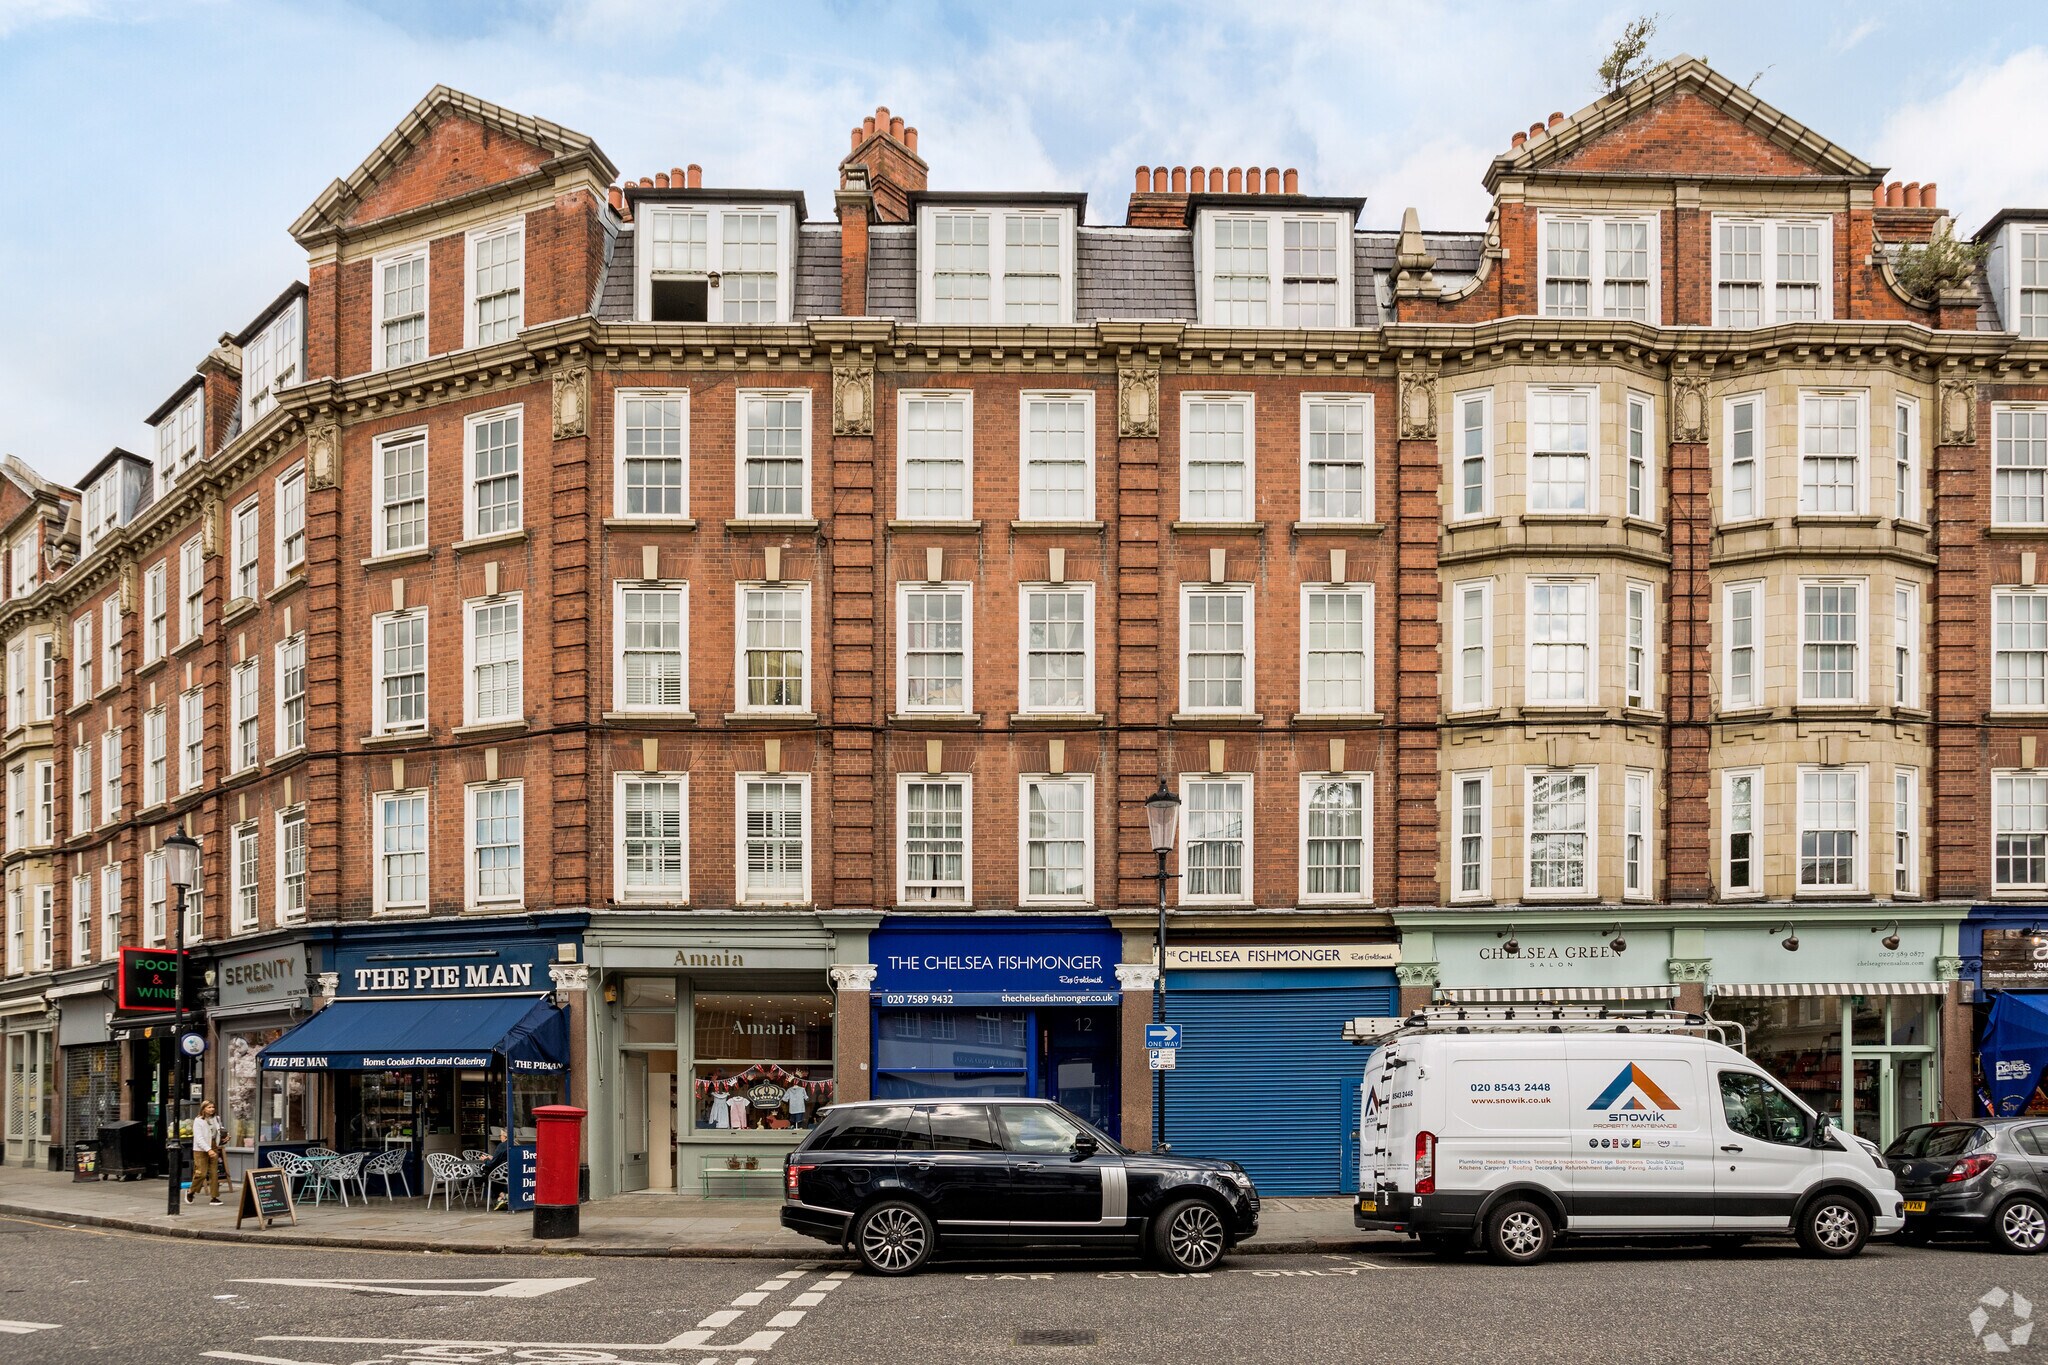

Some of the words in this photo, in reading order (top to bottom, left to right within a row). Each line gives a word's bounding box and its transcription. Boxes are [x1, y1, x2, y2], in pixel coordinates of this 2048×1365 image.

[674, 949, 743, 966] Amaia
[1178, 950, 1241, 962] CHELSEA
[1247, 949, 1341, 962] FISHMONGER
[1565, 947, 1622, 959] GREEN
[135, 960, 178, 971] FOOD
[888, 956, 920, 970] THE
[924, 956, 993, 970] CHELSEA
[998, 955, 1102, 970] FISHMONGER
[225, 957, 295, 985] SERENITY
[355, 968, 409, 990] THE
[414, 966, 459, 989] PIE
[464, 963, 532, 987] MAN
[153, 974, 163, 984] &
[887, 995, 904, 1004] 020
[907, 995, 929, 1004] 7589
[931, 995, 953, 1004] 9432
[1001, 994, 1113, 1004] thechelseafishmonger.co.uk
[731, 1020, 796, 1035] Amaia
[1075, 1017, 1092, 1031] 12
[269, 1058, 287, 1067] THE
[289, 1058, 305, 1067] PIE
[306, 1057, 328, 1067] MAN
[363, 1058, 385, 1066] Home
[386, 1057, 414, 1066] Cooked
[415, 1057, 436, 1066] Food
[436, 1057, 452, 1065] and
[453, 1056, 487, 1067] Catering
[514, 1060, 532, 1069] THE
[1470, 1083, 1491, 1092] 020
[1494, 1083, 1521, 1092] 8543
[1524, 1083, 1551, 1092] 2448
[1608, 1110, 1665, 1122] snowik
